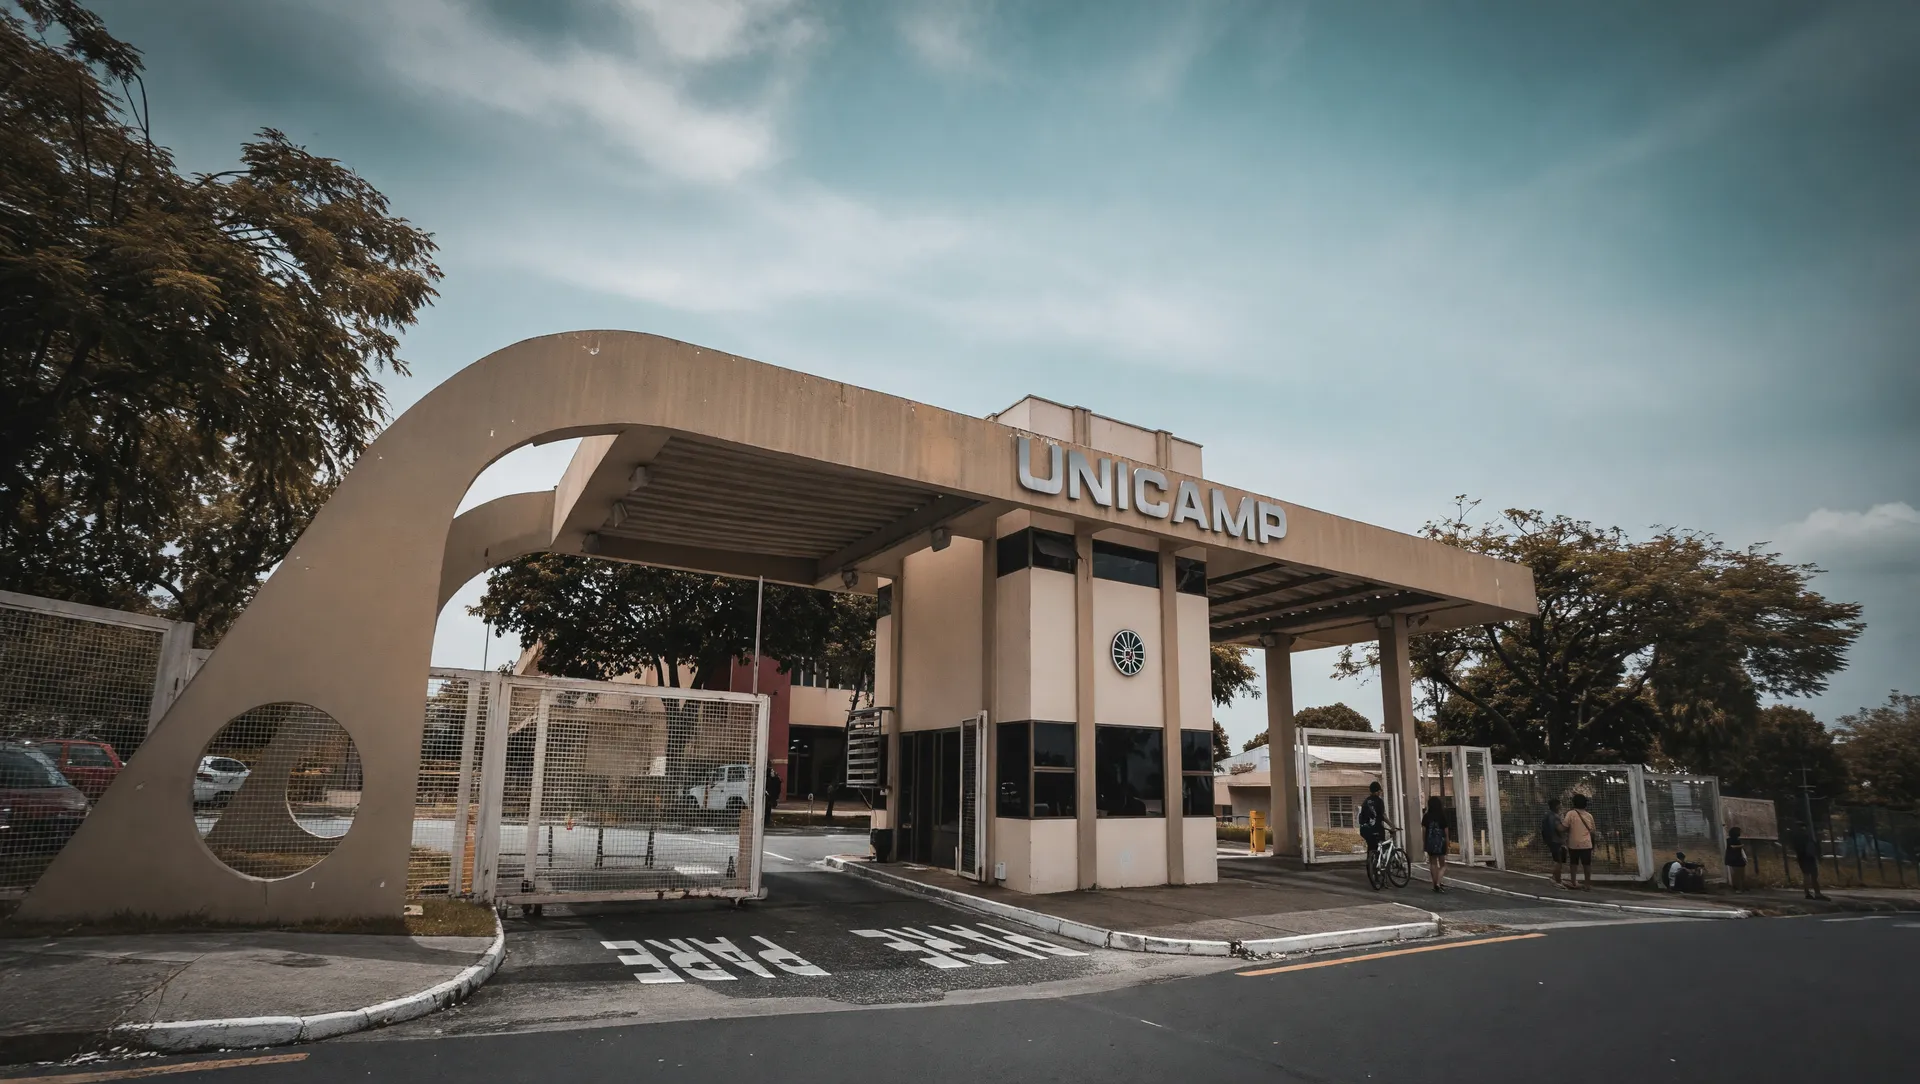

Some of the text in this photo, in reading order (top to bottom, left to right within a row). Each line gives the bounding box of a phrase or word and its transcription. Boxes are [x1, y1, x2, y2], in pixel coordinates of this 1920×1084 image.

[1017, 437, 1287, 543] UNICAMP
[600, 935, 831, 984] PARE
[849, 923, 1089, 968] PARE
